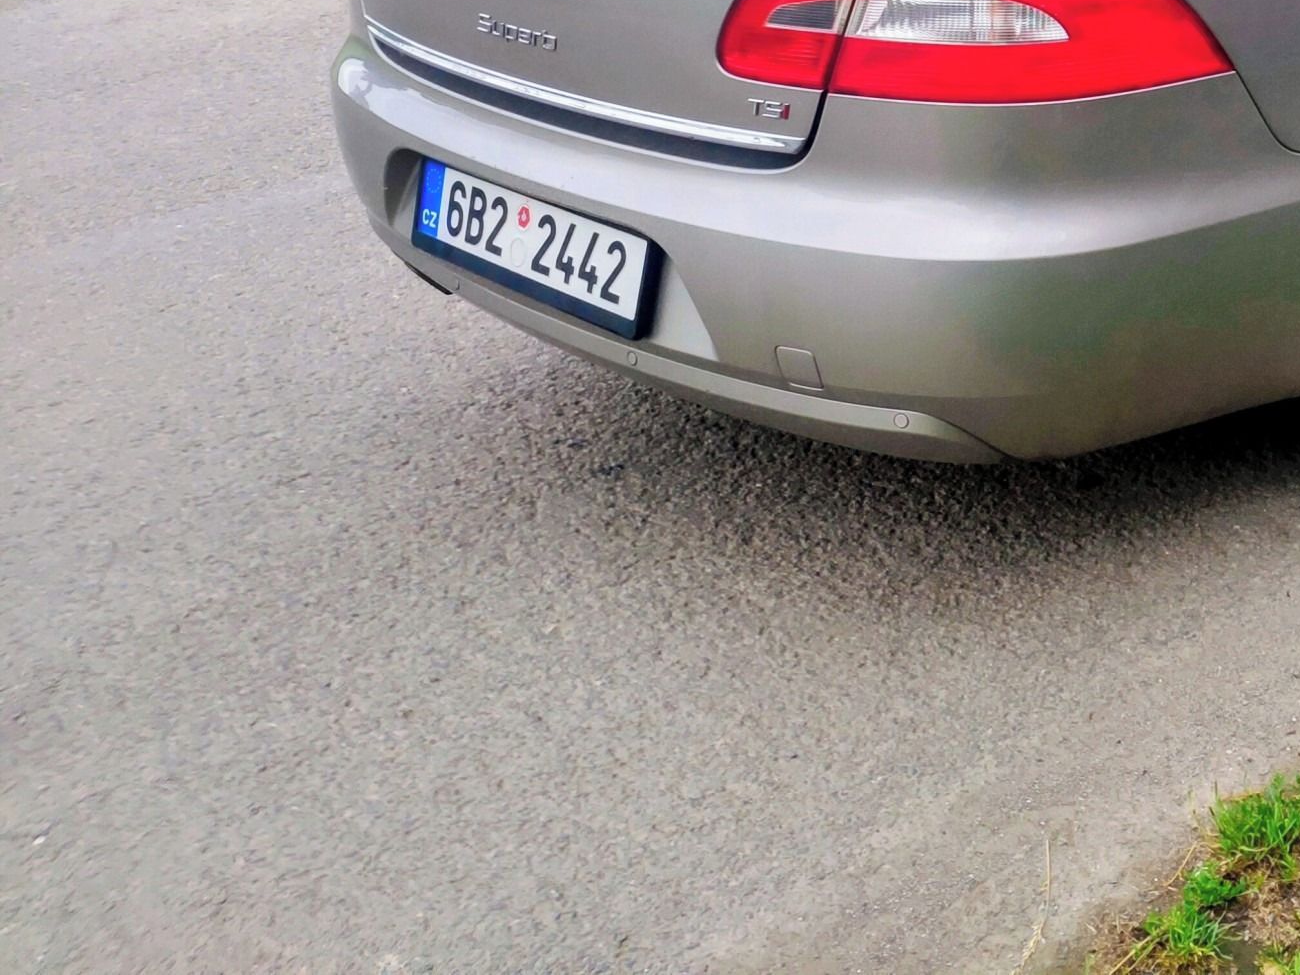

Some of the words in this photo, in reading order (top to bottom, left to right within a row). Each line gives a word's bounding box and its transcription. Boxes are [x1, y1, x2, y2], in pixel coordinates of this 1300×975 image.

[477, 13, 558, 52] Superb
[422, 208, 438, 228] CZ
[446, 180, 508, 256] 6B2
[530, 214, 627, 304] 2442
